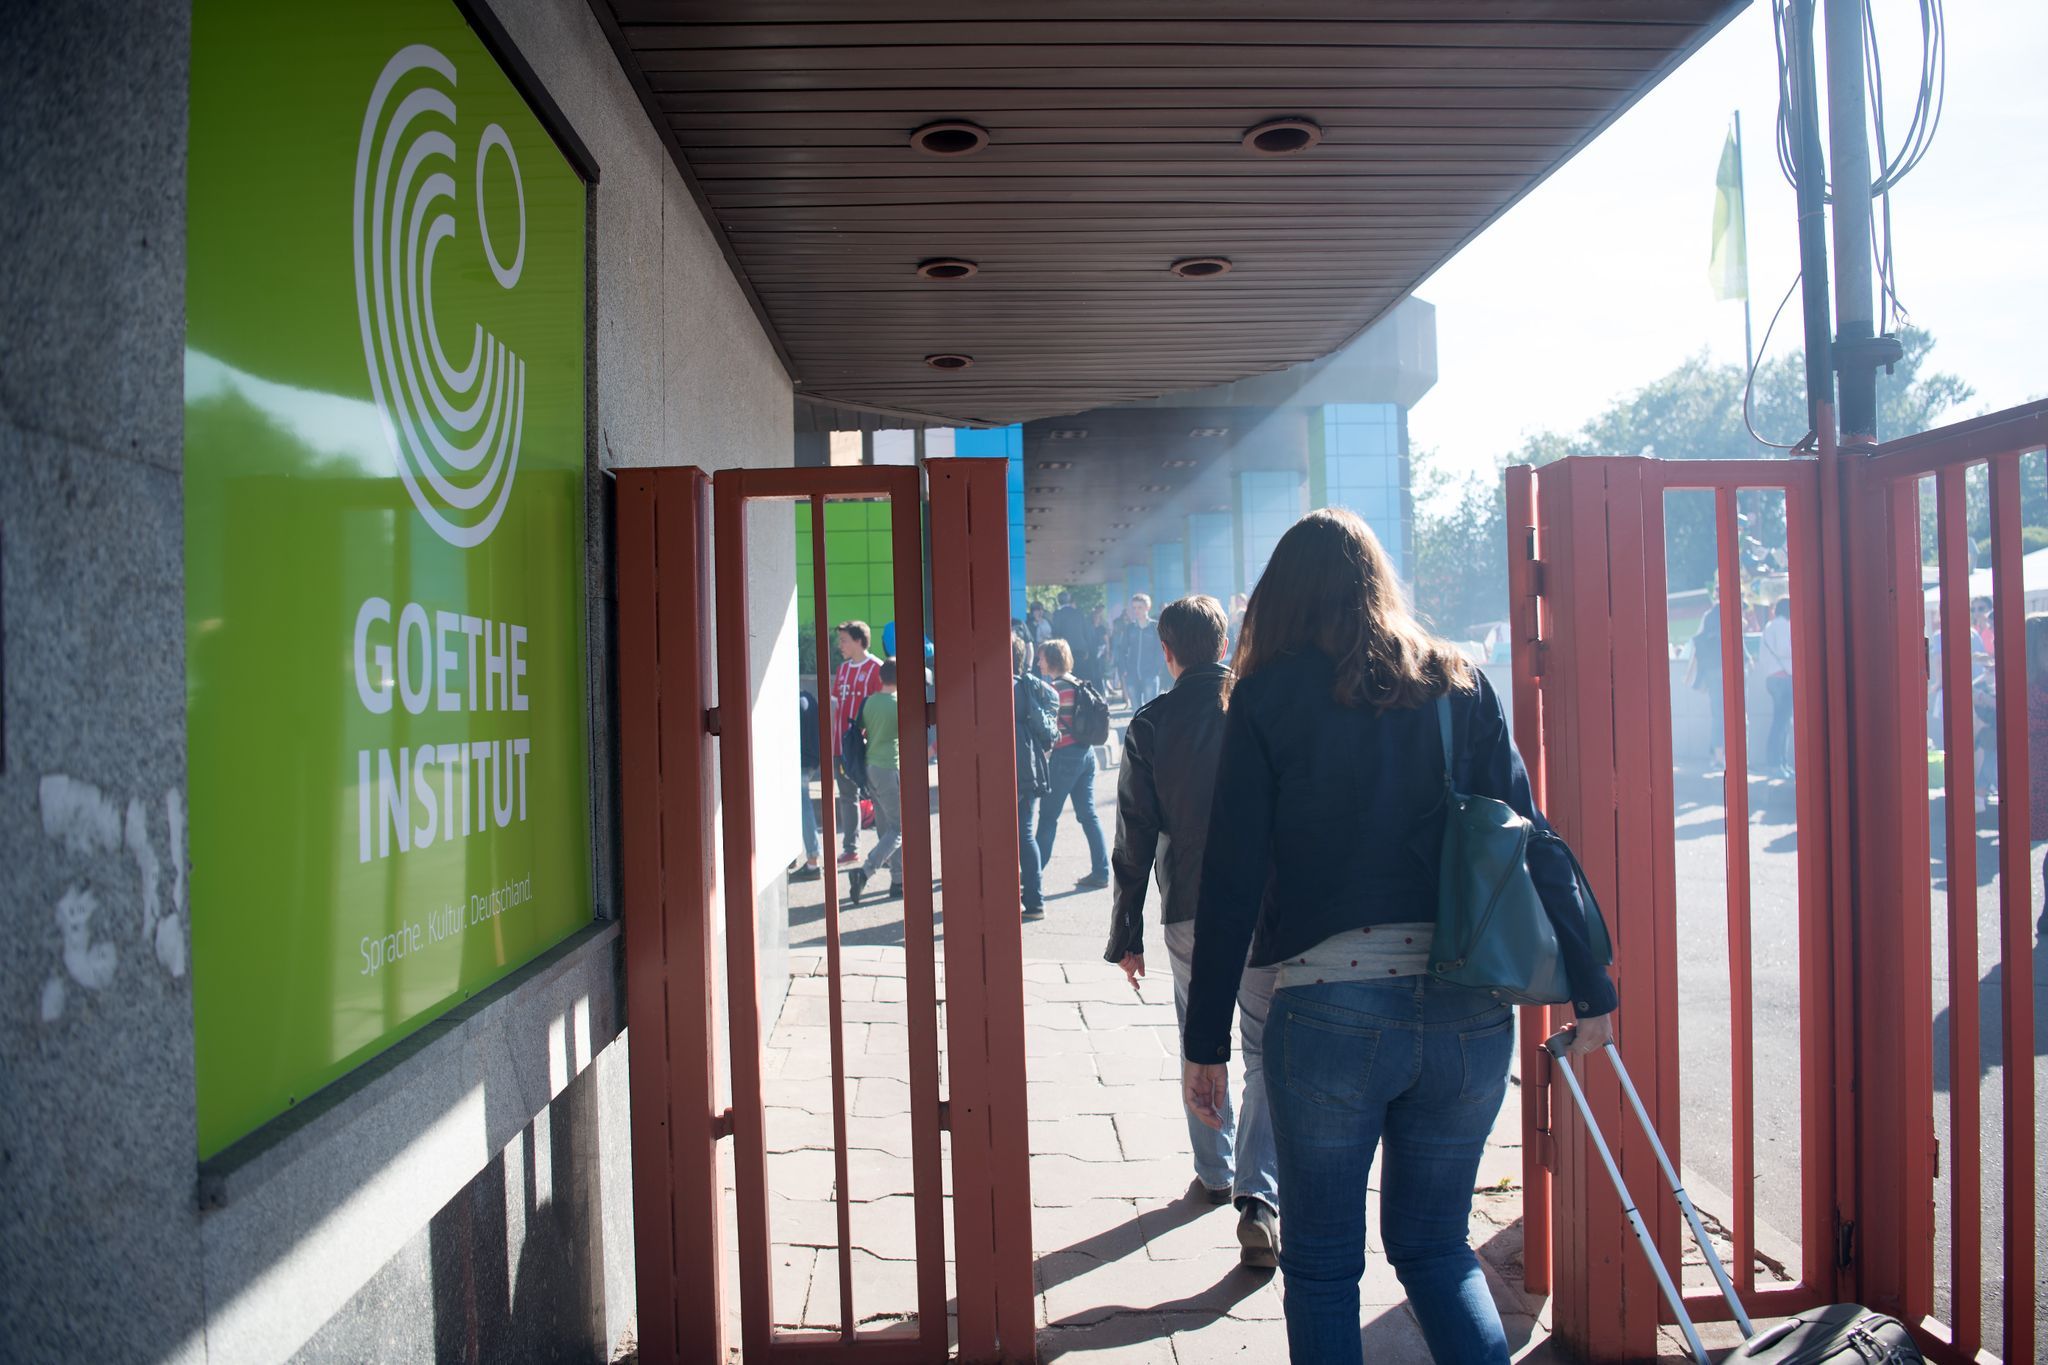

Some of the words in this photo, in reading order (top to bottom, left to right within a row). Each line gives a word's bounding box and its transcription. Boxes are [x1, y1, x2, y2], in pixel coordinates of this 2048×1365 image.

[354, 597, 529, 715] GOETHE
[358, 738, 531, 864] INSTITUT
[360, 920, 424, 976] Sprache.
[428, 904, 467, 944] Kultur.
[471, 872, 533, 925] Deutschland.
